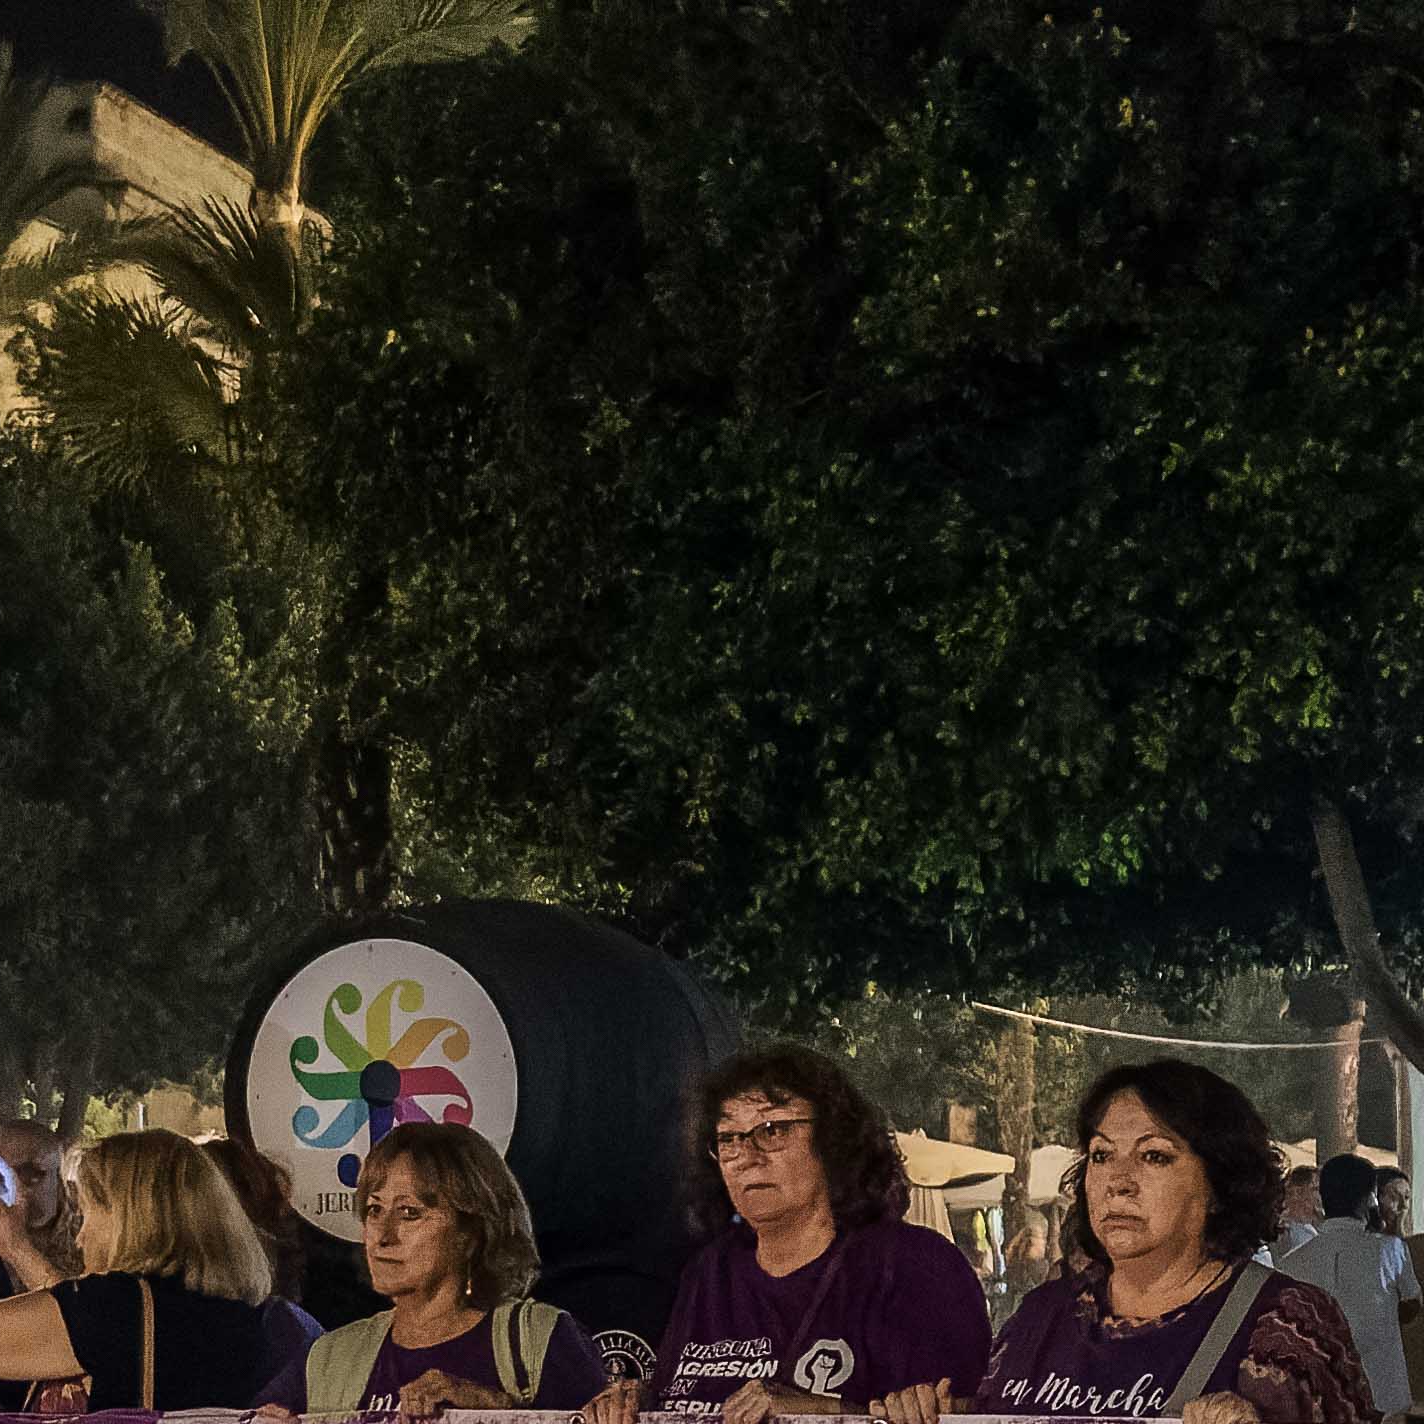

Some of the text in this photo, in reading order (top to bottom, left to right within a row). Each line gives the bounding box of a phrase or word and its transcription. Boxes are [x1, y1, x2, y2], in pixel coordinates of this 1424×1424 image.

[316, 1192, 358, 1215] JER
[1001, 1371, 1168, 1417] en Marcha
